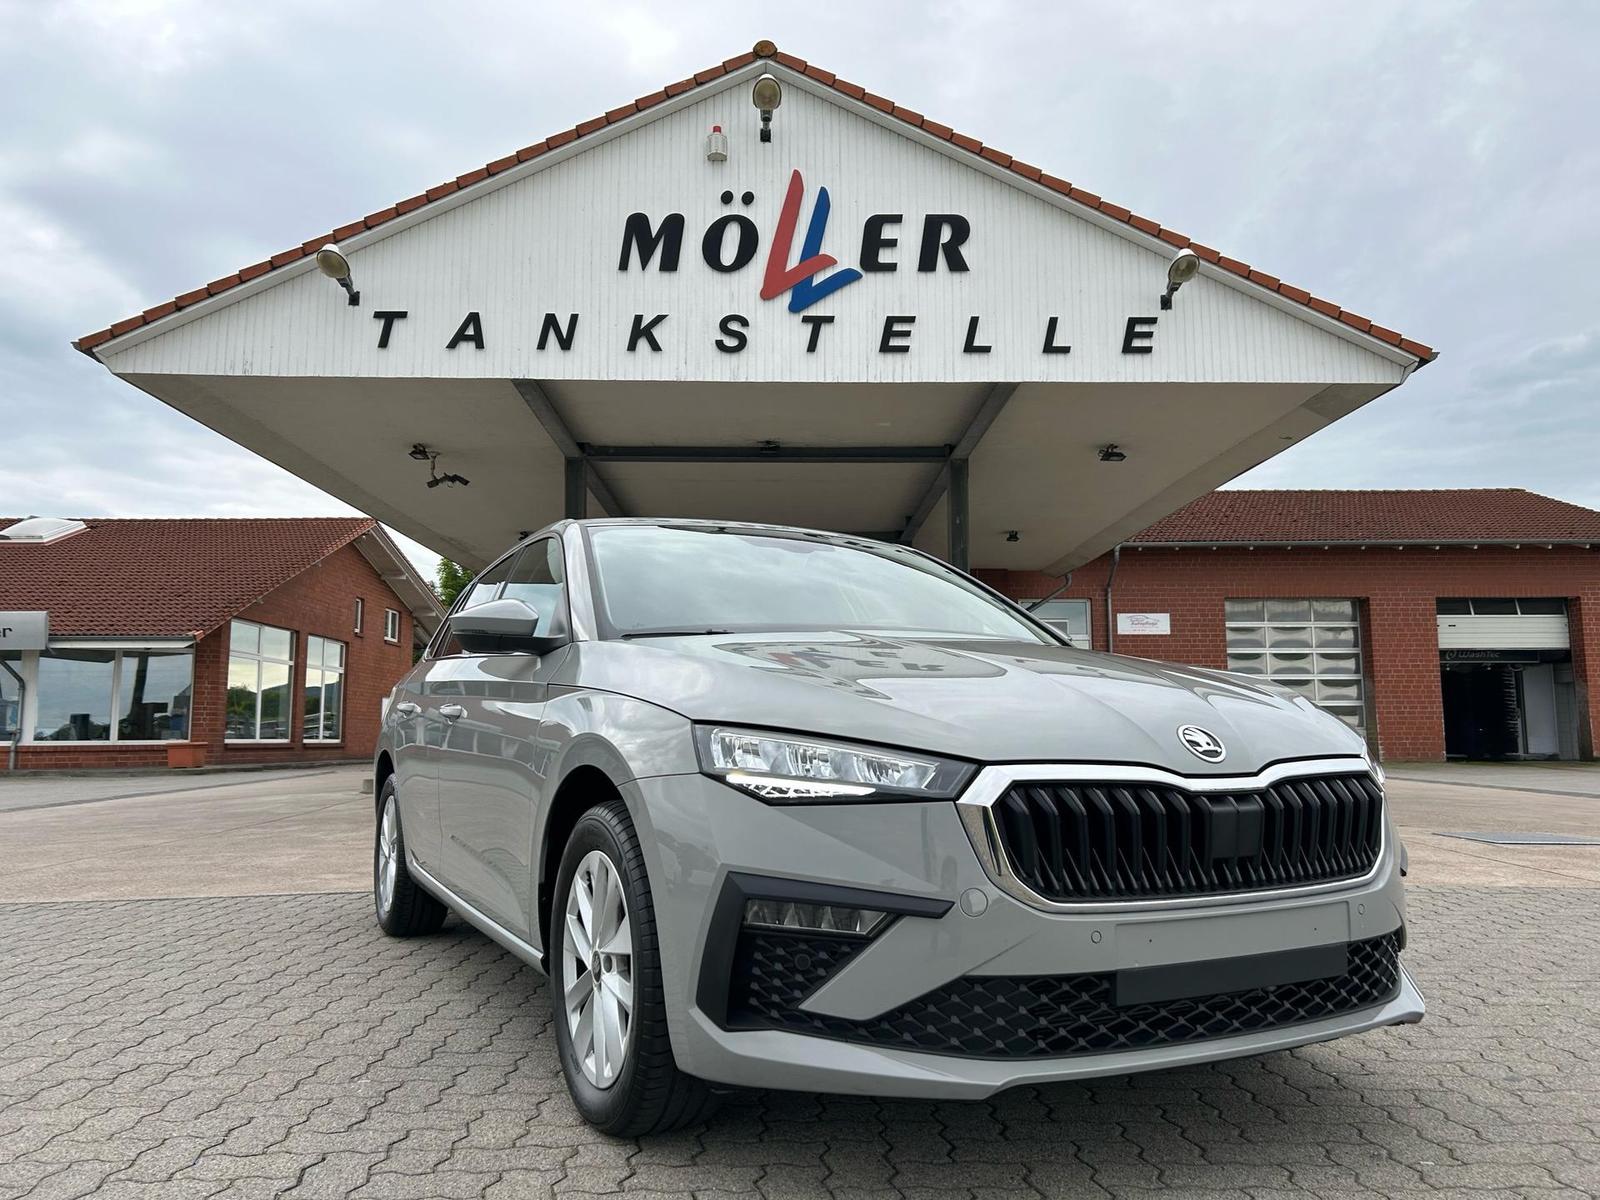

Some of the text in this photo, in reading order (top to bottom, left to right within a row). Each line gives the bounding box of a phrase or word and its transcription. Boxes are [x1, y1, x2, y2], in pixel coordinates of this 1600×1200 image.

[619, 169, 971, 313] MÖLLER
[372, 310, 1160, 355] TANKSTELLE
[0, 627, 13, 638] r
